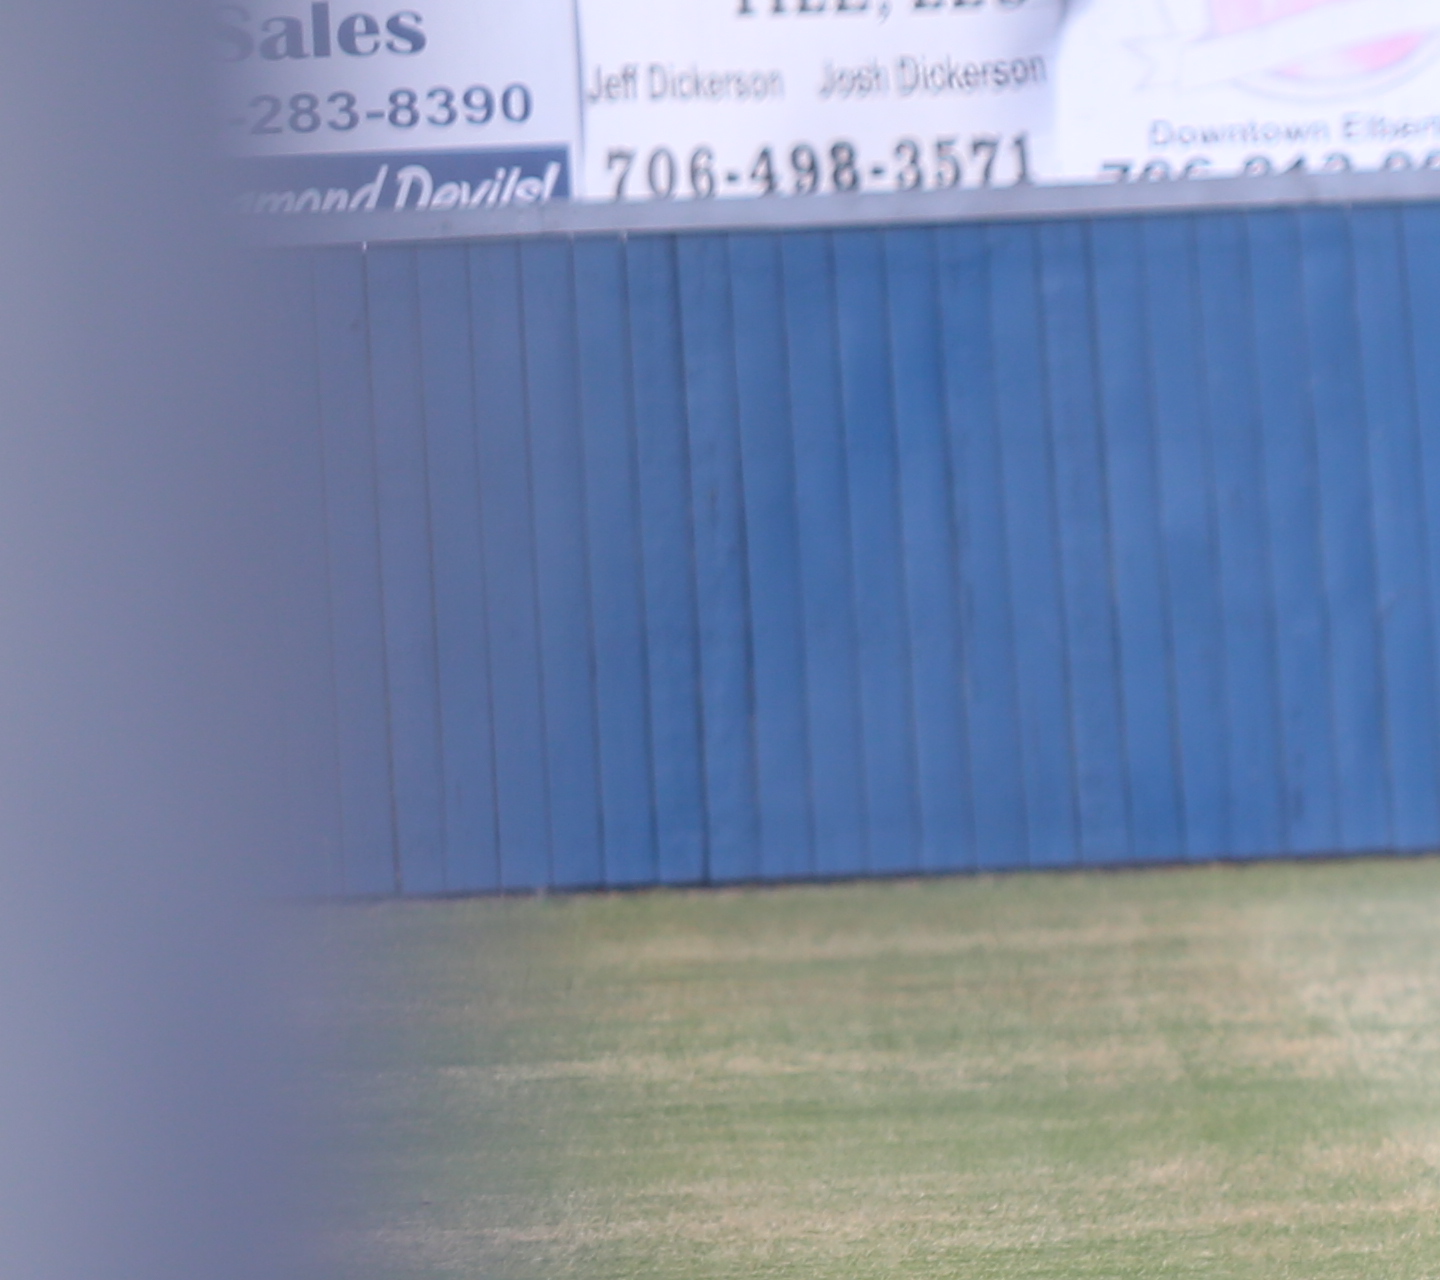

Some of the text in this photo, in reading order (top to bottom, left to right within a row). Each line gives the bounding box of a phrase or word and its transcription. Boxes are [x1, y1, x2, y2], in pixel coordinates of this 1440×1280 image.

[587, 63, 785, 103] Jeff Dickerson
[818, 54, 1047, 99] Josh Dickerson
[1150, 117, 1331, 147] Downtown
[243, 163, 388, 213] mond
[606, 133, 1033, 201] 706-498-3571
